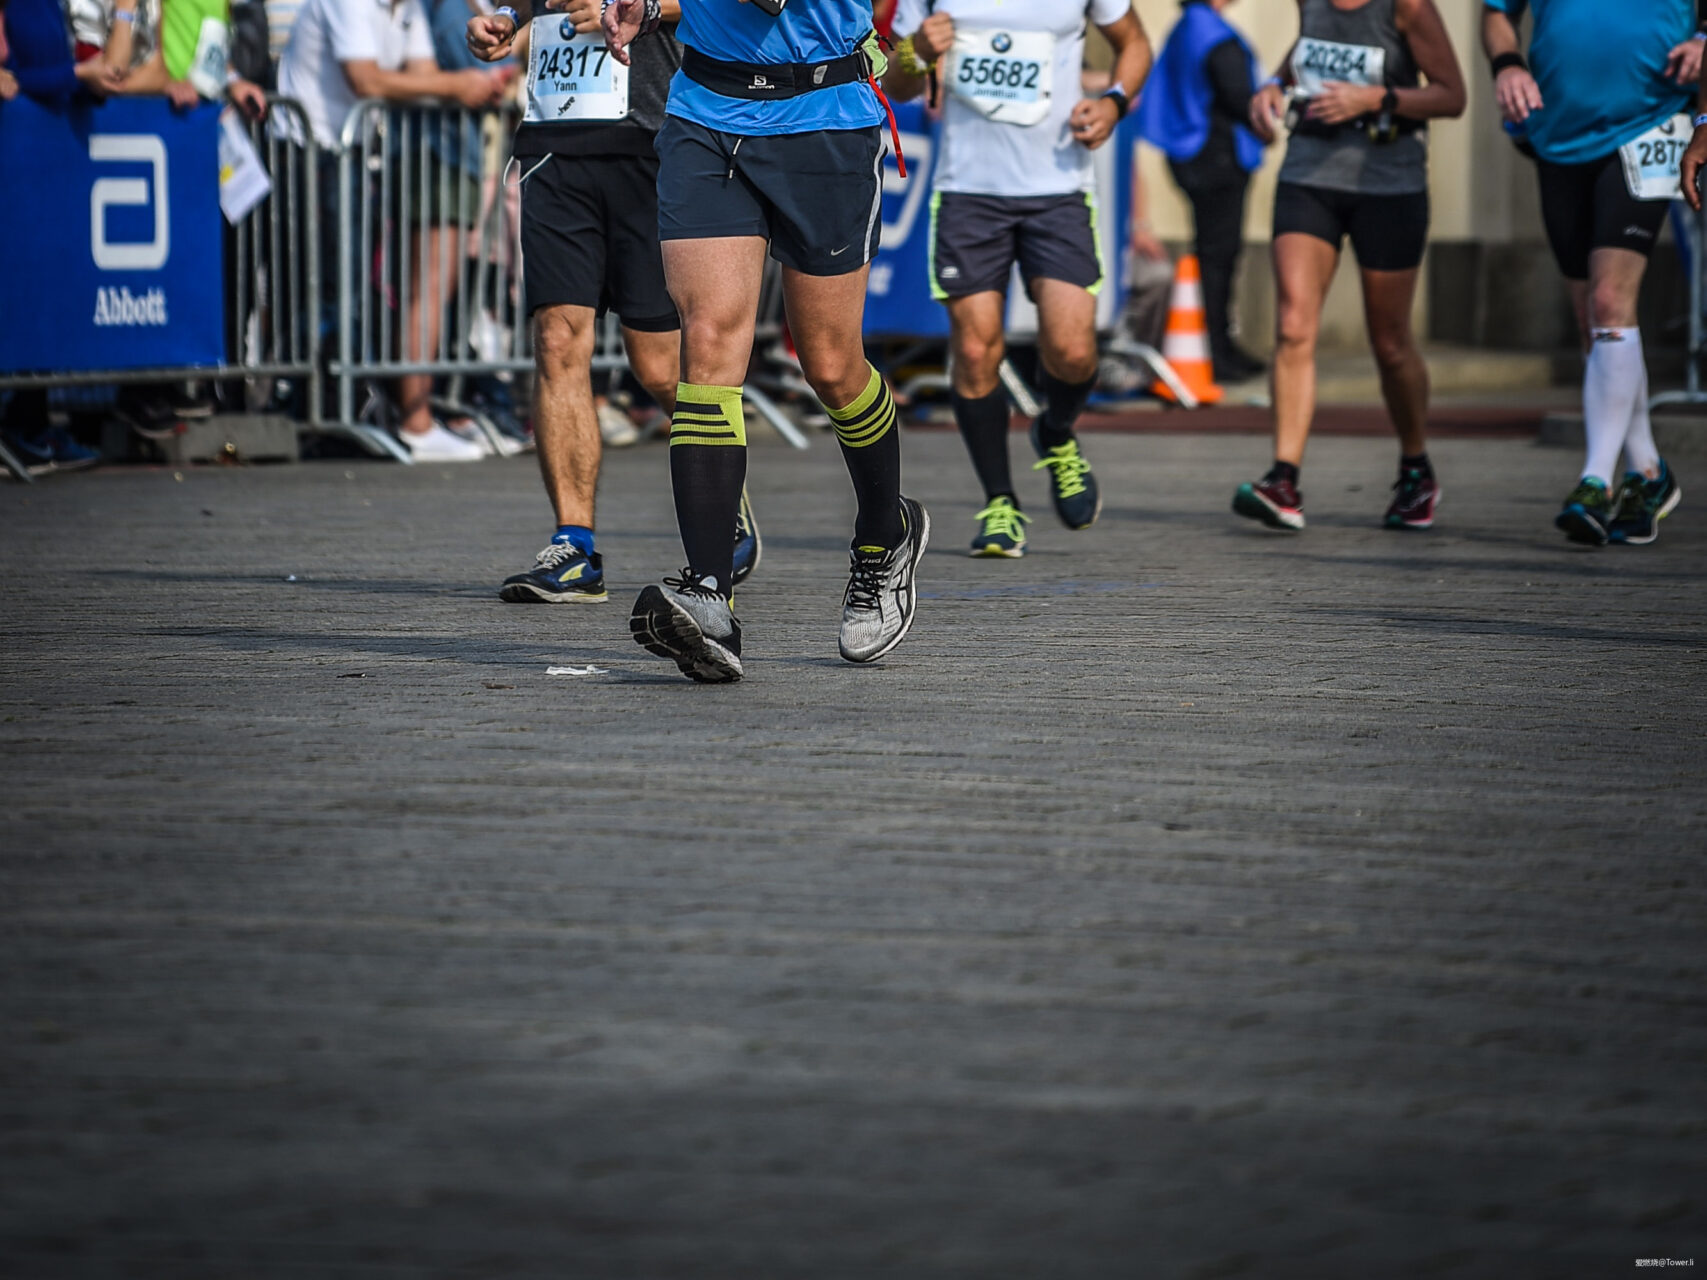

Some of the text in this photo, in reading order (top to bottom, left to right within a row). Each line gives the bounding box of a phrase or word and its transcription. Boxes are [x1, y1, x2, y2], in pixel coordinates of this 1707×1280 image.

[538, 46, 609, 80] 24317
[958, 58, 1040, 88] 55682
[554, 81, 577, 91] Yann
[93, 286, 168, 327] Abbott
